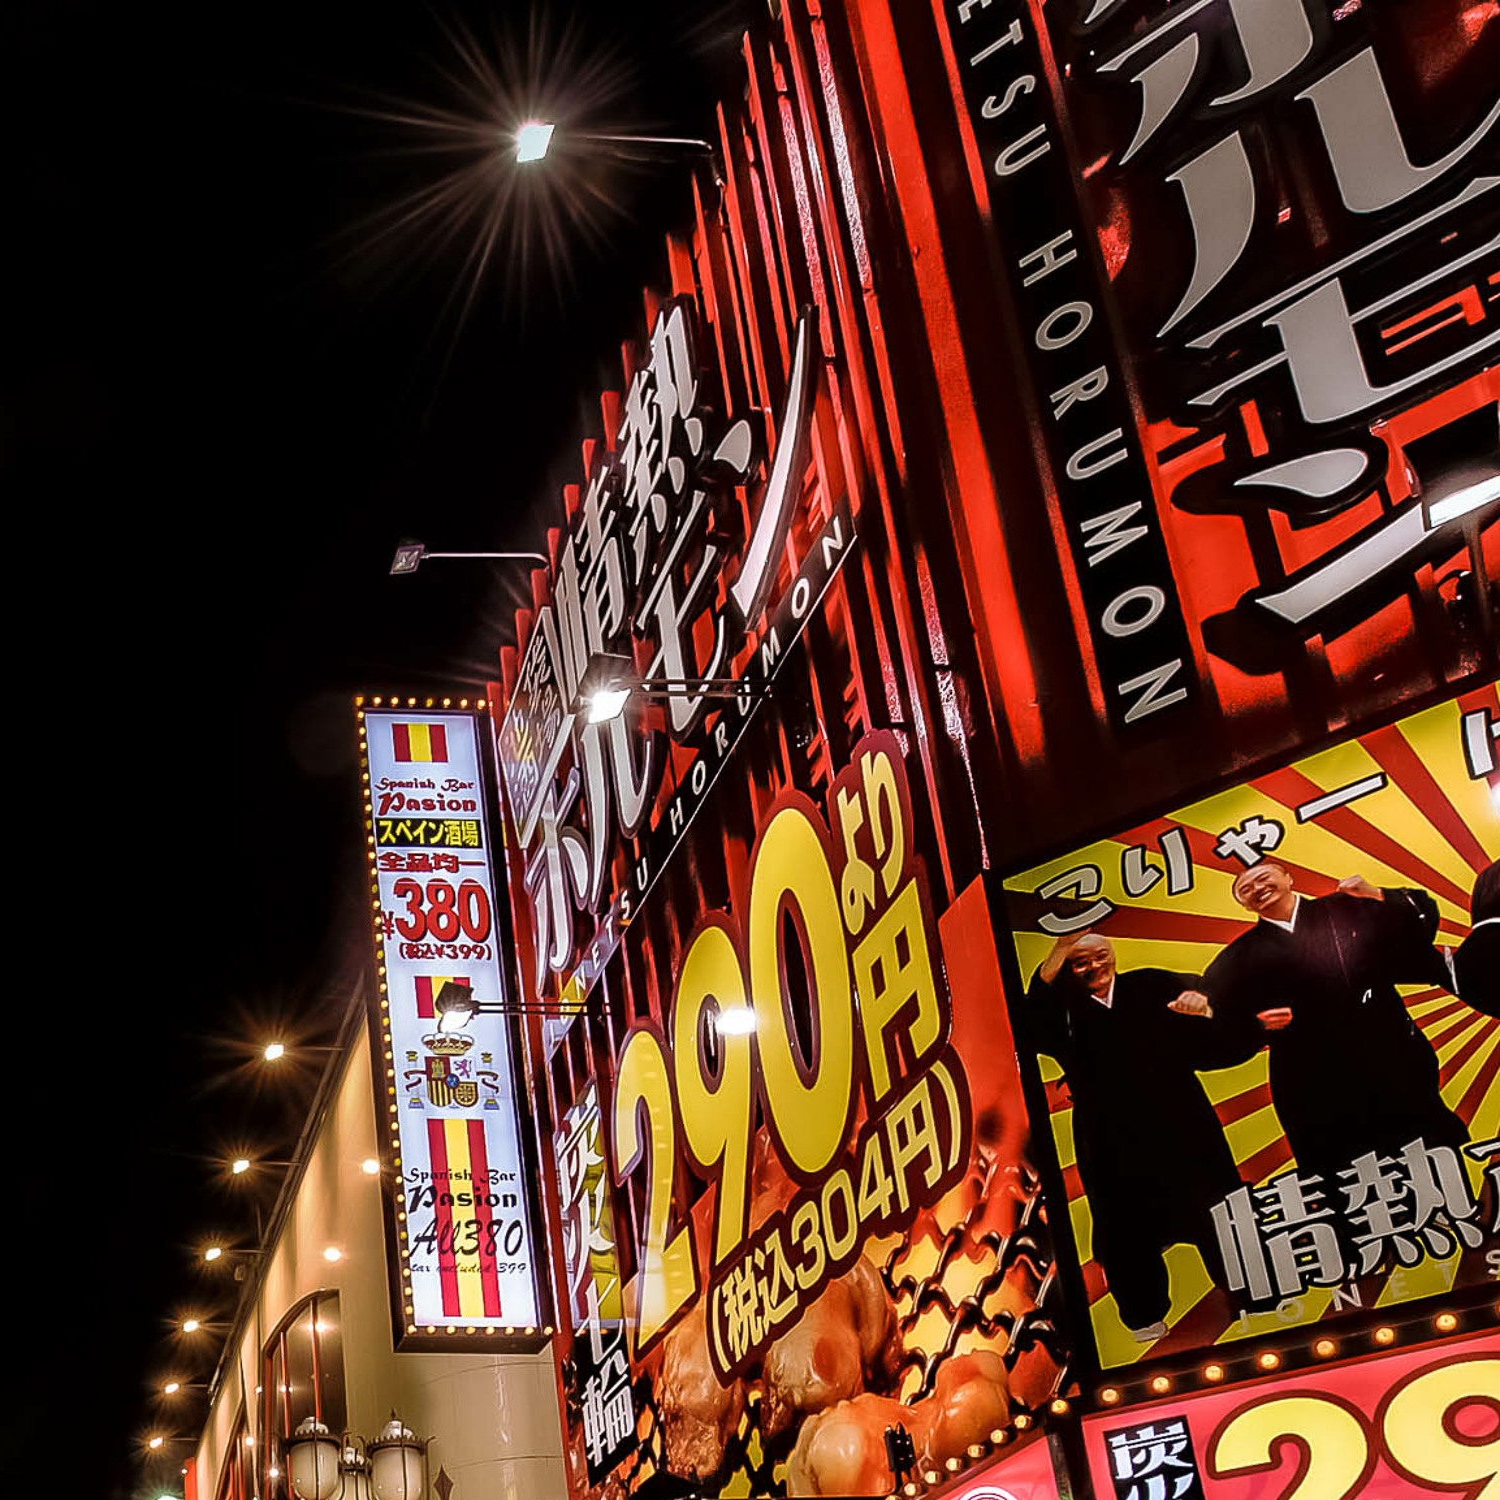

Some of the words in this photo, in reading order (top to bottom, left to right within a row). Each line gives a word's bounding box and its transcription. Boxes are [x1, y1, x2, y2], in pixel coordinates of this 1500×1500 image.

[1018, 230, 1188, 723] HORUMON
[670, 516, 846, 835] HORUMON
[375, 777, 436, 792] Spanish
[441, 777, 475, 792] Bar
[377, 791, 477, 816] Pasion
[378, 819, 480, 847] スペイン酒場
[377, 852, 486, 873] 全品均一
[403, 1167, 473, 1184] Spanish
[480, 1167, 516, 1184] Bar
[408, 1183, 518, 1215] Pasion
[1209, 1136, 1500, 1301] 情熱
